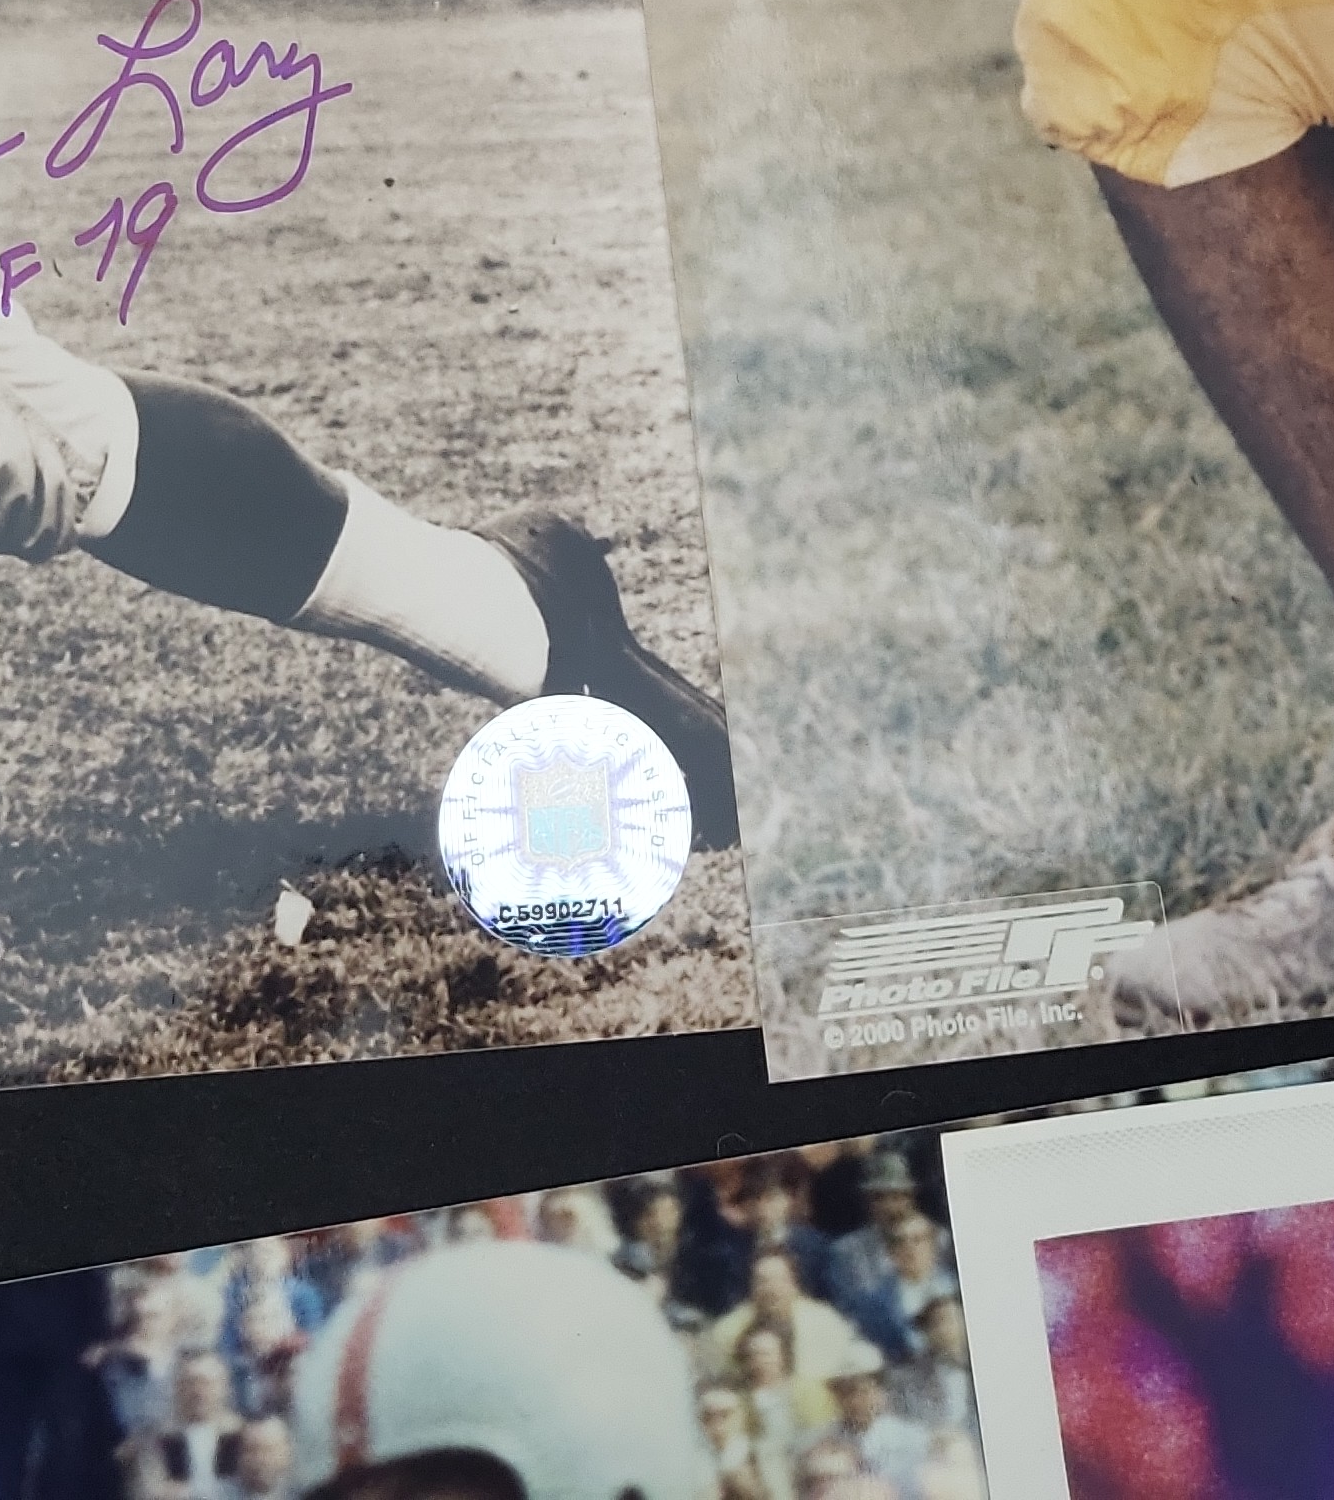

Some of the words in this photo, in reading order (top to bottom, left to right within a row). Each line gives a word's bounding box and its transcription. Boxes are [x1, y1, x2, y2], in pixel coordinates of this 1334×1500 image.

[75, 183, 178, 326] 79
[818, 977, 953, 1013] Photo
[958, 965, 1043, 996] File
[851, 1019, 904, 1046] 2000
[911, 1013, 976, 1039] Photo
[986, 1006, 1036, 1031] File,
[1042, 1000, 1083, 1024] Inc.
